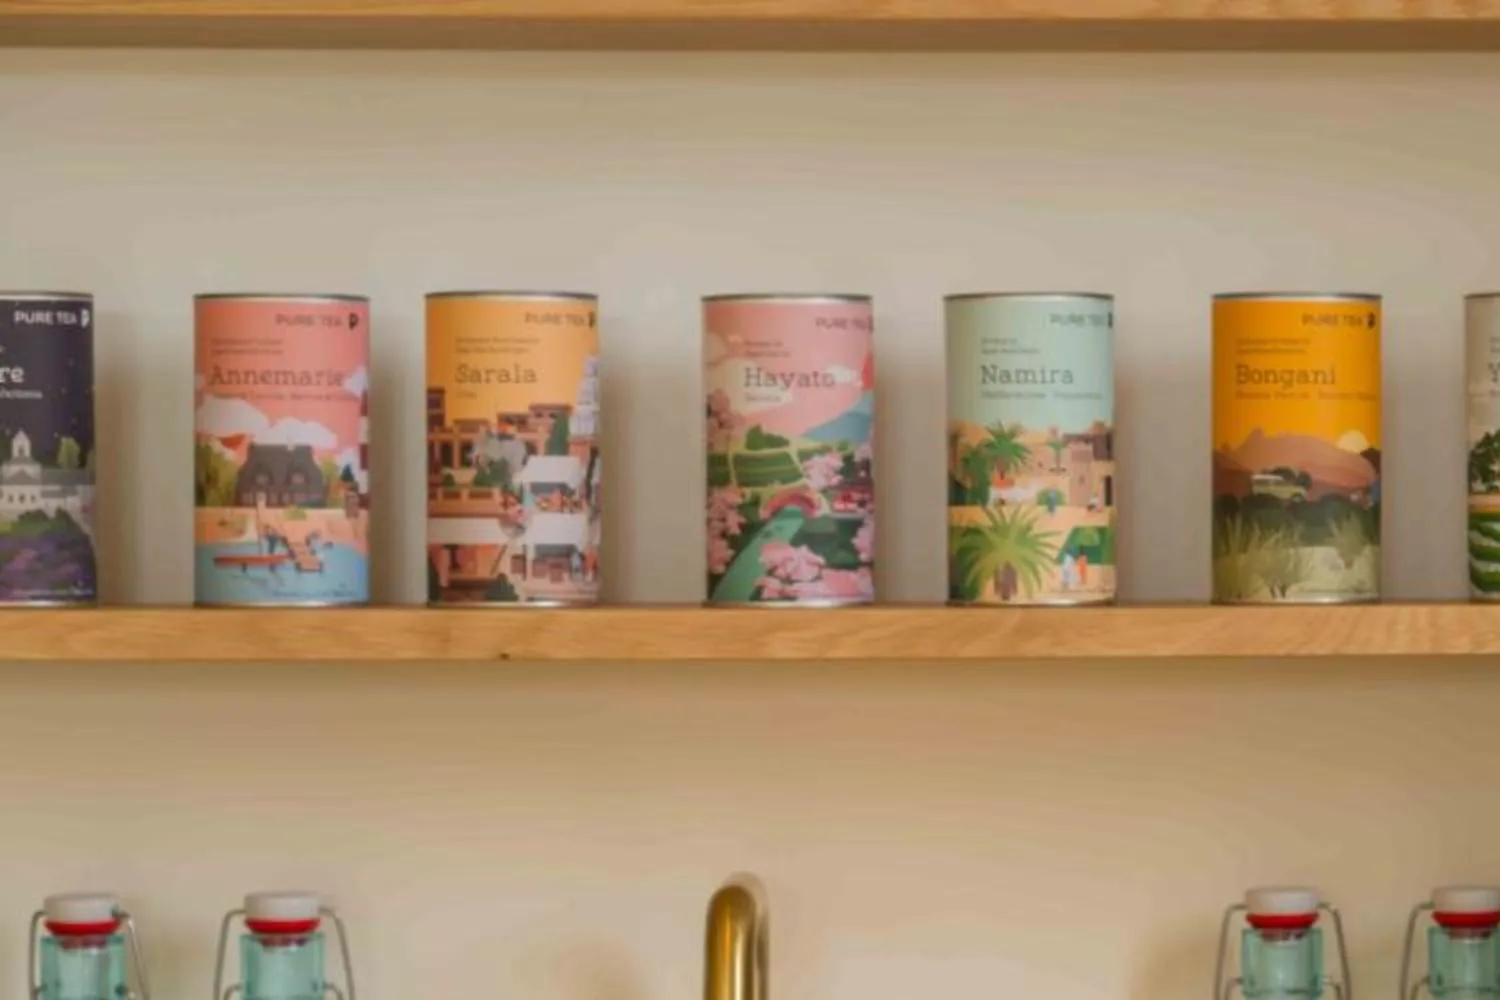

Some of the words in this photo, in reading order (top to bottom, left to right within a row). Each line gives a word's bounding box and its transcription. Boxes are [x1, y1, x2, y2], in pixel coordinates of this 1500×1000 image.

[14, 310, 54, 325] PURE
[275, 313, 315, 327] PURE
[524, 312, 562, 325] PURE
[208, 364, 344, 388] Annemarie
[454, 362, 538, 384] Sarala
[744, 367, 836, 391] Hayato
[980, 364, 1074, 385] Namira
[1235, 364, 1336, 391] Bongani
